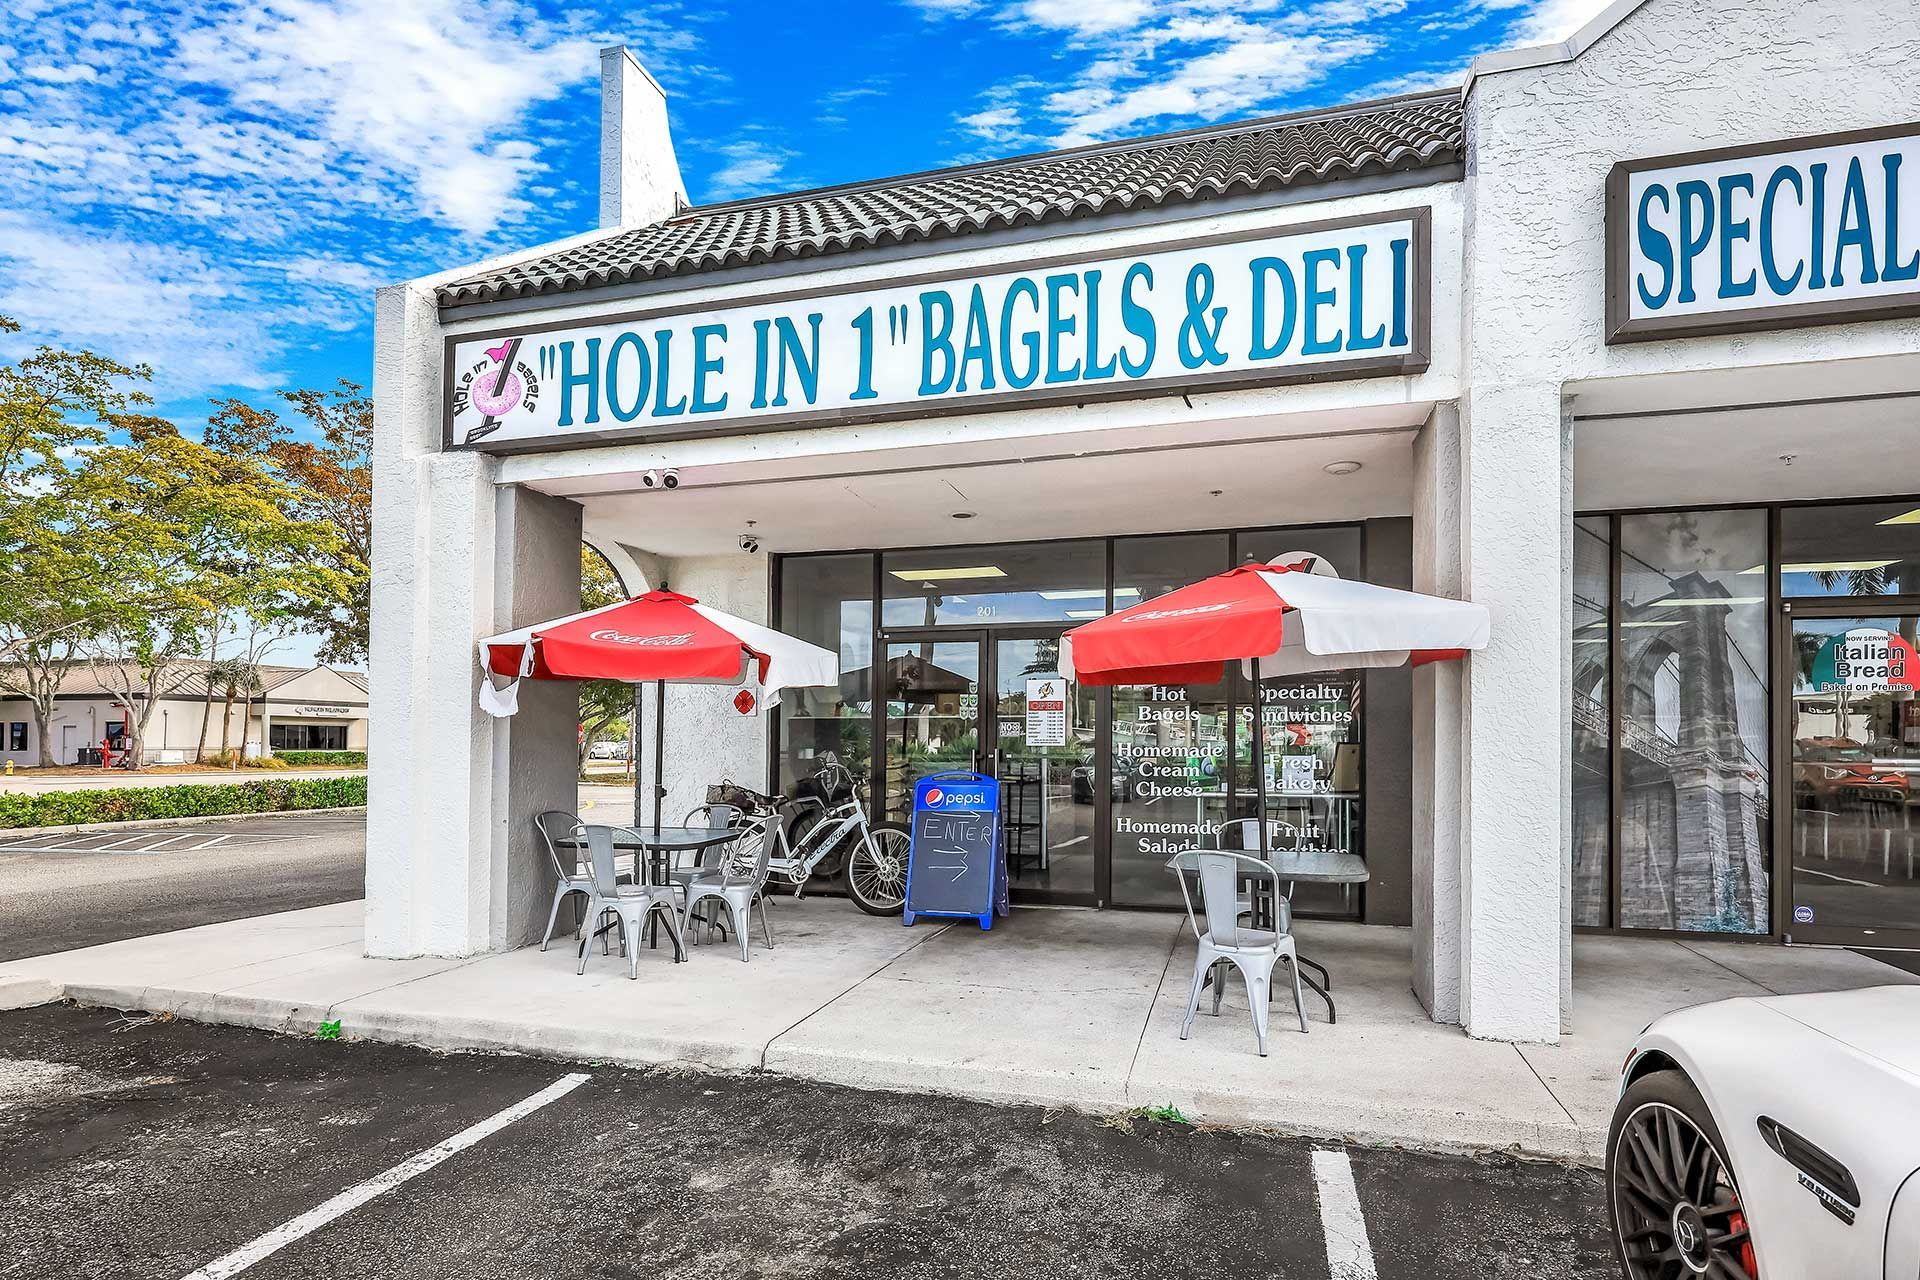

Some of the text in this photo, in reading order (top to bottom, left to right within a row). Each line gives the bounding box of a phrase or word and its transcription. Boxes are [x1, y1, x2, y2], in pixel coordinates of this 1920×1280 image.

[1637, 153, 1920, 310] SPECIAL
[750, 312, 823, 419] IN
[850, 303, 908, 400] 1"
[918, 262, 1156, 397] BAGELS
[1177, 262, 1228, 369] &
[1248, 238, 1409, 360] DELI
[977, 606, 996, 617] 201
[590, 629, 697, 646] Coca-Cola
[1835, 644, 1905, 660] Italian
[1836, 662, 1904, 678] Bread
[1152, 687, 1186, 701] Hot
[1822, 683, 1853, 691] Baked
[1871, 683, 1913, 691] Premise
[1138, 706, 1200, 725] Bagels
[1243, 706, 1352, 722] Sndwiches
[1117, 742, 1223, 758] Homemade
[1138, 762, 1200, 777] Cream
[1269, 754, 1324, 770] Fresh
[1136, 781, 1203, 797] Cheese
[945, 792, 985, 806] pepsi
[923, 819, 992, 846] ENTER
[1116, 817, 1222, 835] Homemade
[1798, 1173, 1855, 1219] V8 BITURBO
